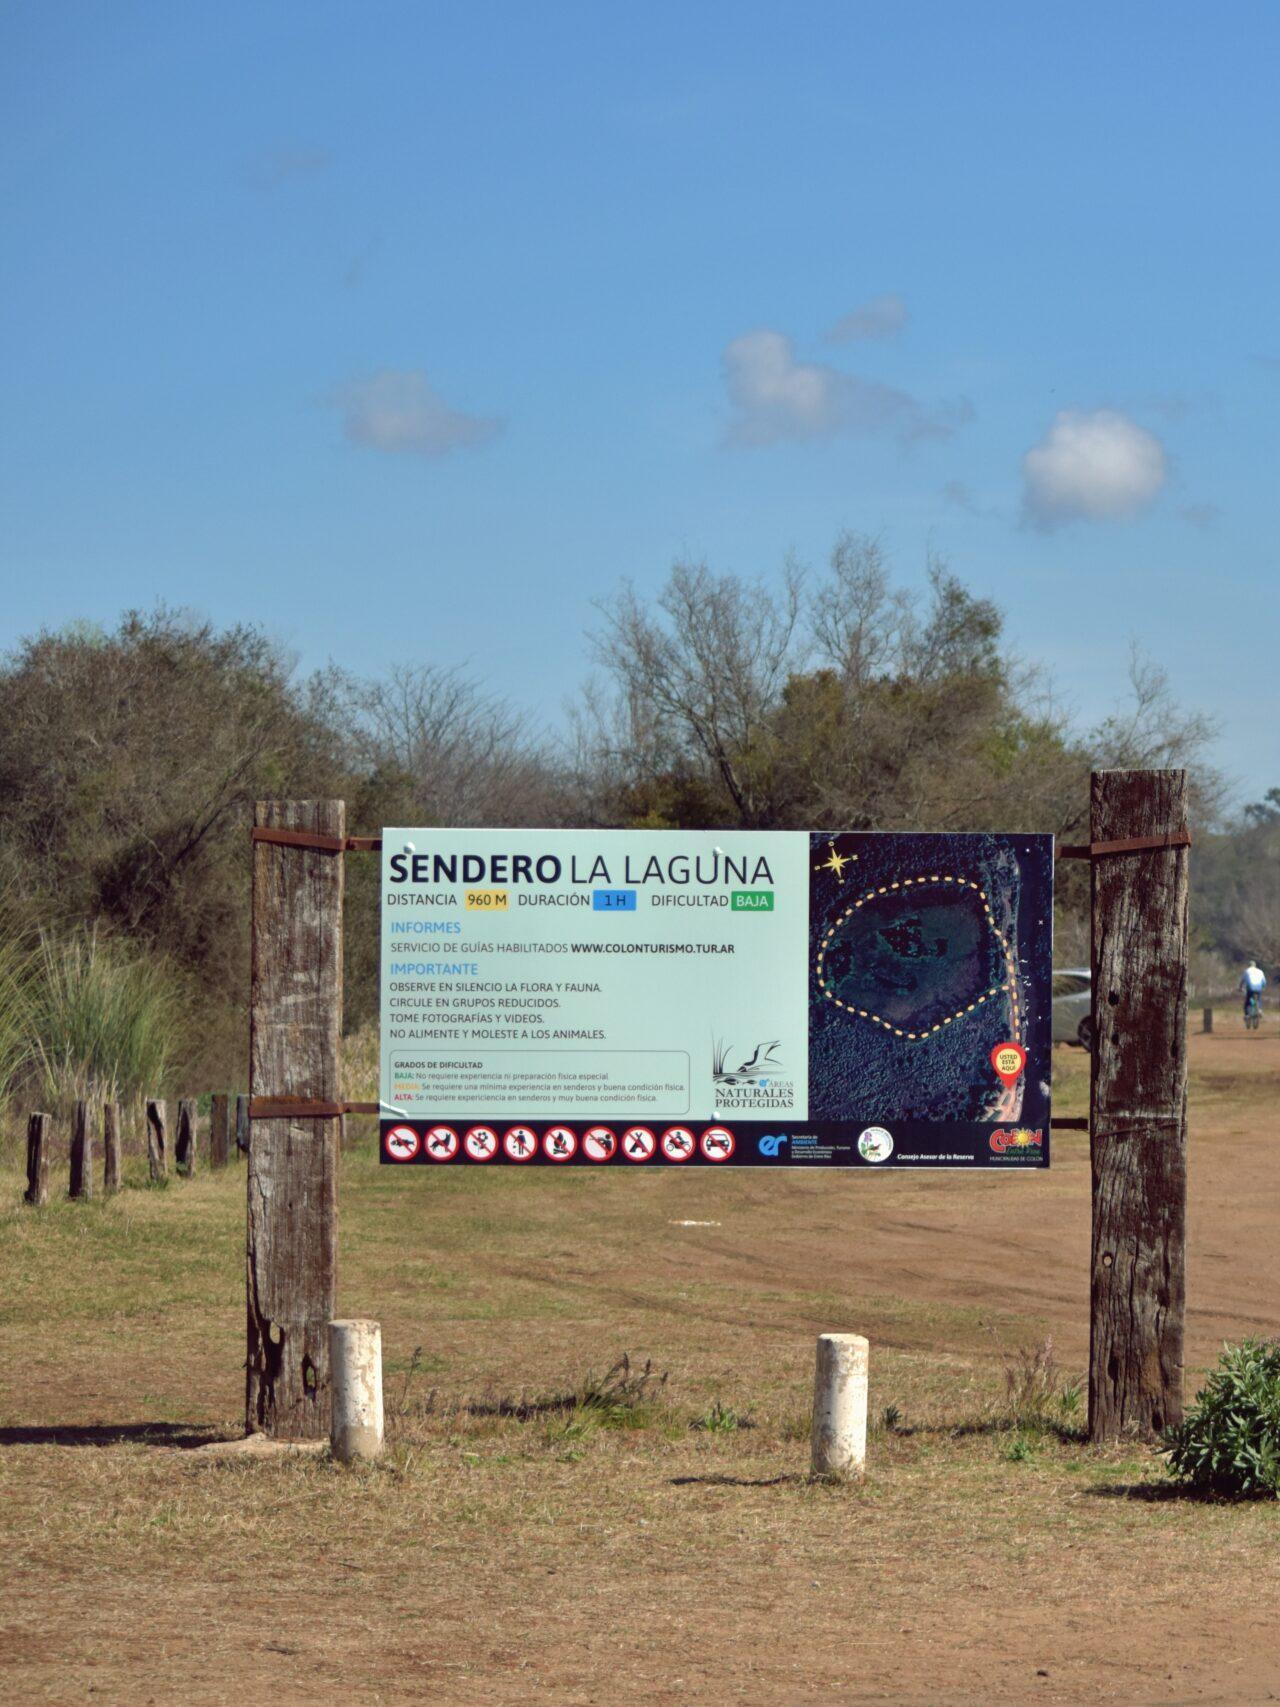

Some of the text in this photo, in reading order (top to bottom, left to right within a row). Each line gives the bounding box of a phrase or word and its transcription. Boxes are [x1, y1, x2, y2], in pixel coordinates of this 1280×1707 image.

[389, 853, 774, 885] SENDERO LA LAGUNA
[387, 894, 457, 906] DISTANCIA
[467, 894, 507, 906] 960 M
[518, 892, 590, 907] DURACIÓN
[604, 894, 627, 907] 1 H
[651, 894, 729, 907] DIFICULTAD
[736, 895, 769, 907] BAJA
[391, 921, 462, 934] INFORMES
[390, 941, 735, 954] SERVICIO DE GUÍAS HABILITADOS WWW.COLONTURISMO.TUR.AR
[390, 963, 478, 976] IMPORTANTE
[389, 982, 436, 992] OBSERVE
[439, 982, 453, 992] EN
[455, 982, 502, 992] SILENCIO
[505, 983, 518, 993] LA
[520, 983, 554, 993] FLORA
[555, 983, 562, 993] Y
[389, 998, 561, 1008] CIRCULE EN GRUPOS REDUCIDOS.
[390, 1012, 545, 1024] TOME FOTOGRAFÍAS Y VIDEOS.
[390, 1029, 607, 1040] NO ALIMENTE Y MOLESTE A LOS ANIMALES.
[394, 1061, 483, 1069] GRADOS DE DIFICULTAD
[416, 1072, 426, 1080] No
[428, 1072, 459, 1082] requiere
[460, 1072, 502, 1082] experiencia
[504, 1072, 511, 1080] ni
[578, 1073, 608, 1082] especial
[715, 1088, 794, 1098] NATURALES
[715, 1098, 794, 1108] PROTEGIDAS
